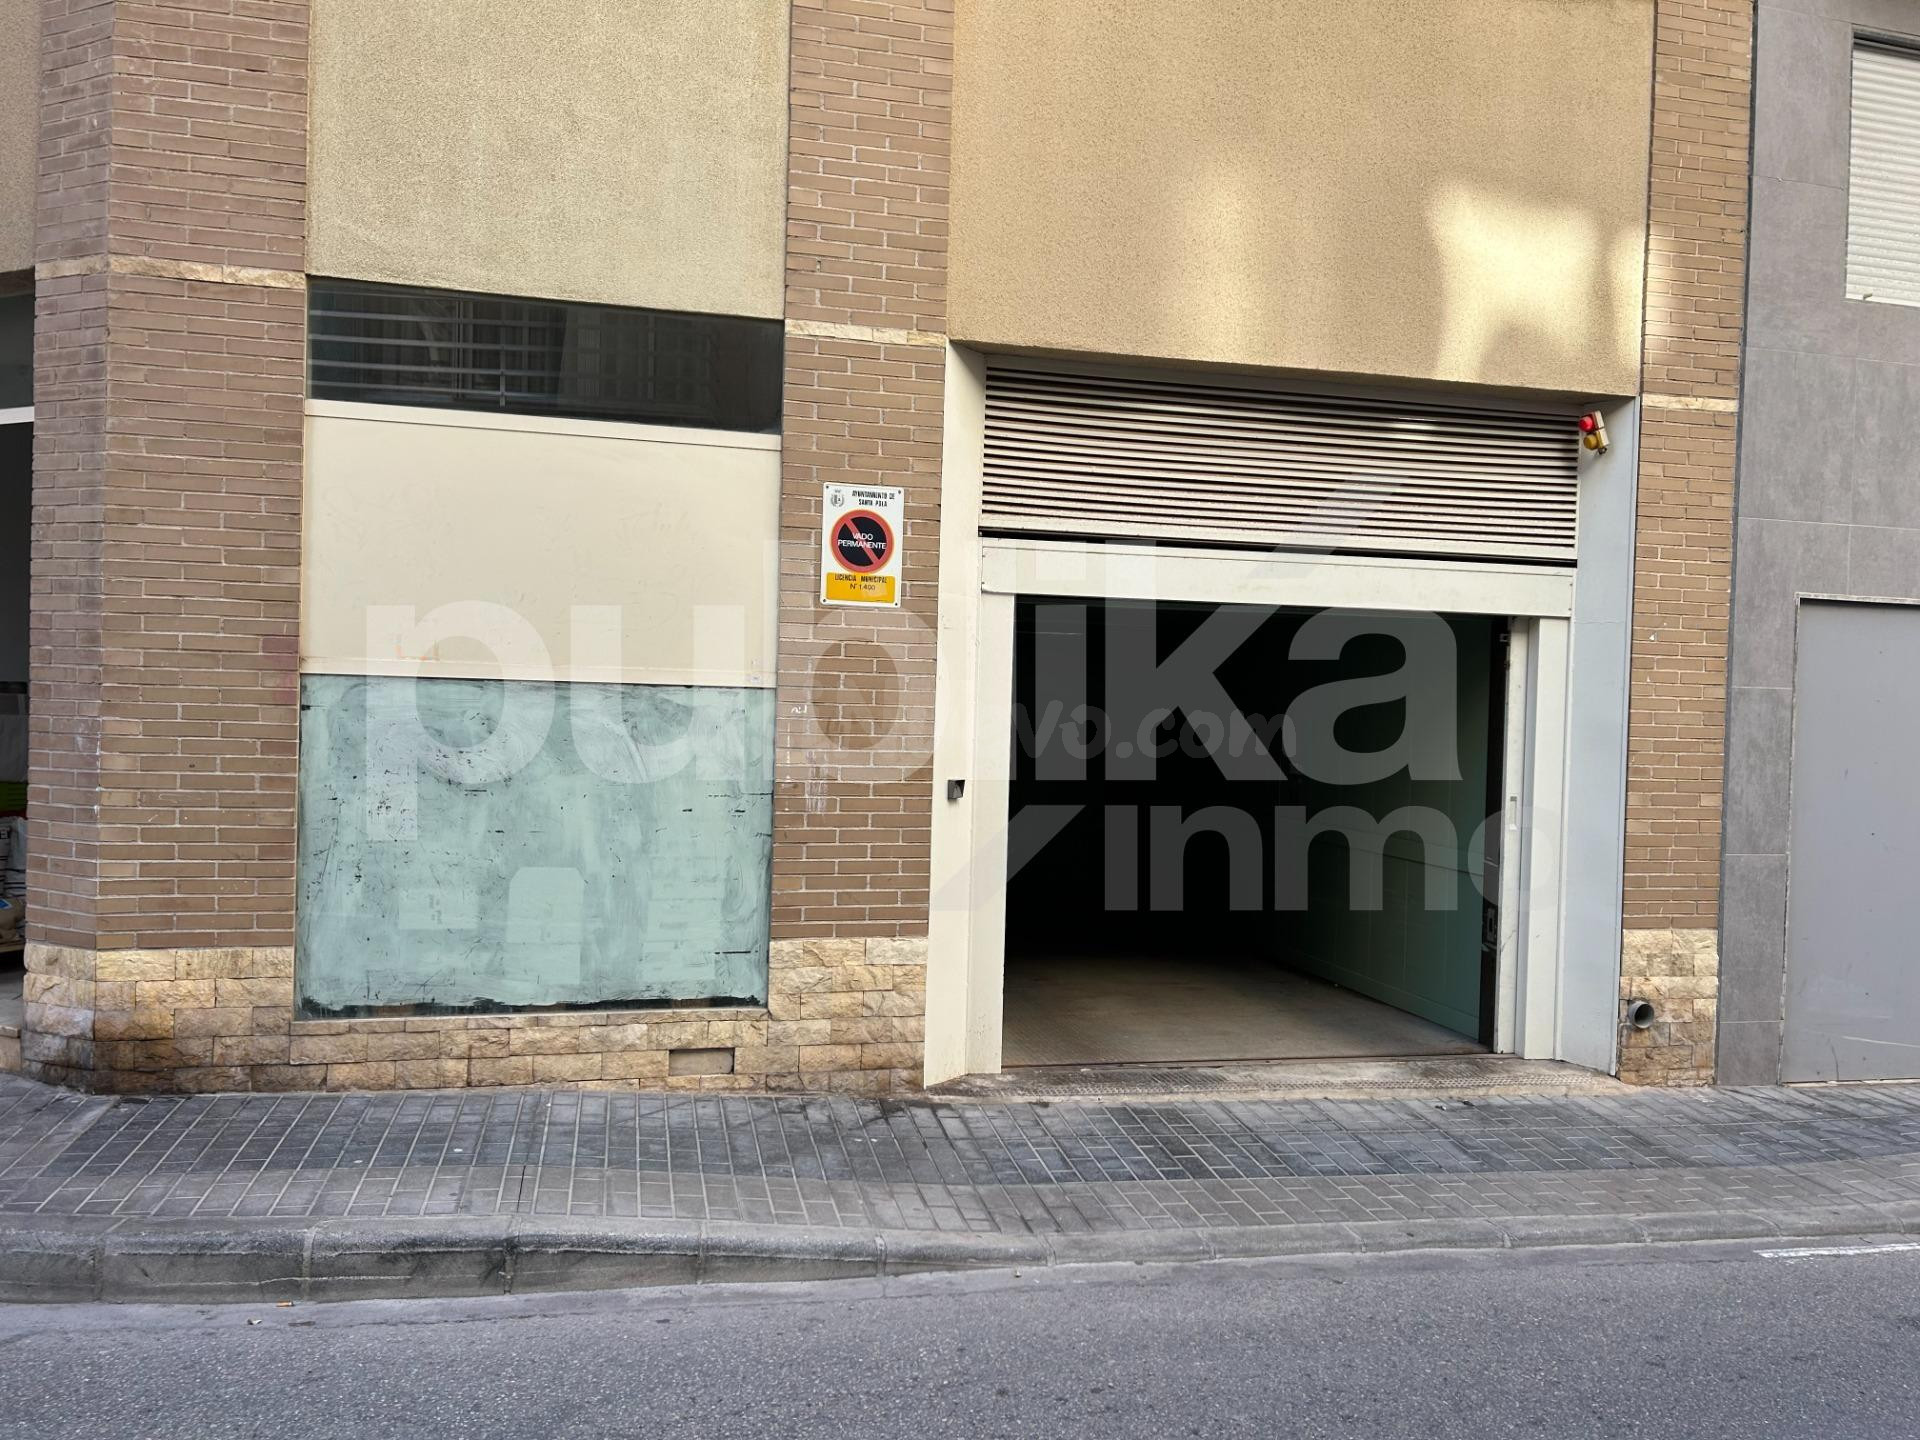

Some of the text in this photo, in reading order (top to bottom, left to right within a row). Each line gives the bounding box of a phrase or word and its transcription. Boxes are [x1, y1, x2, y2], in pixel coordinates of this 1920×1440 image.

[852, 532, 874, 540] VADO
[837, 540, 887, 549] PERMANENTE
[834, 573, 888, 583] LICENCIA MUNICIPAL
